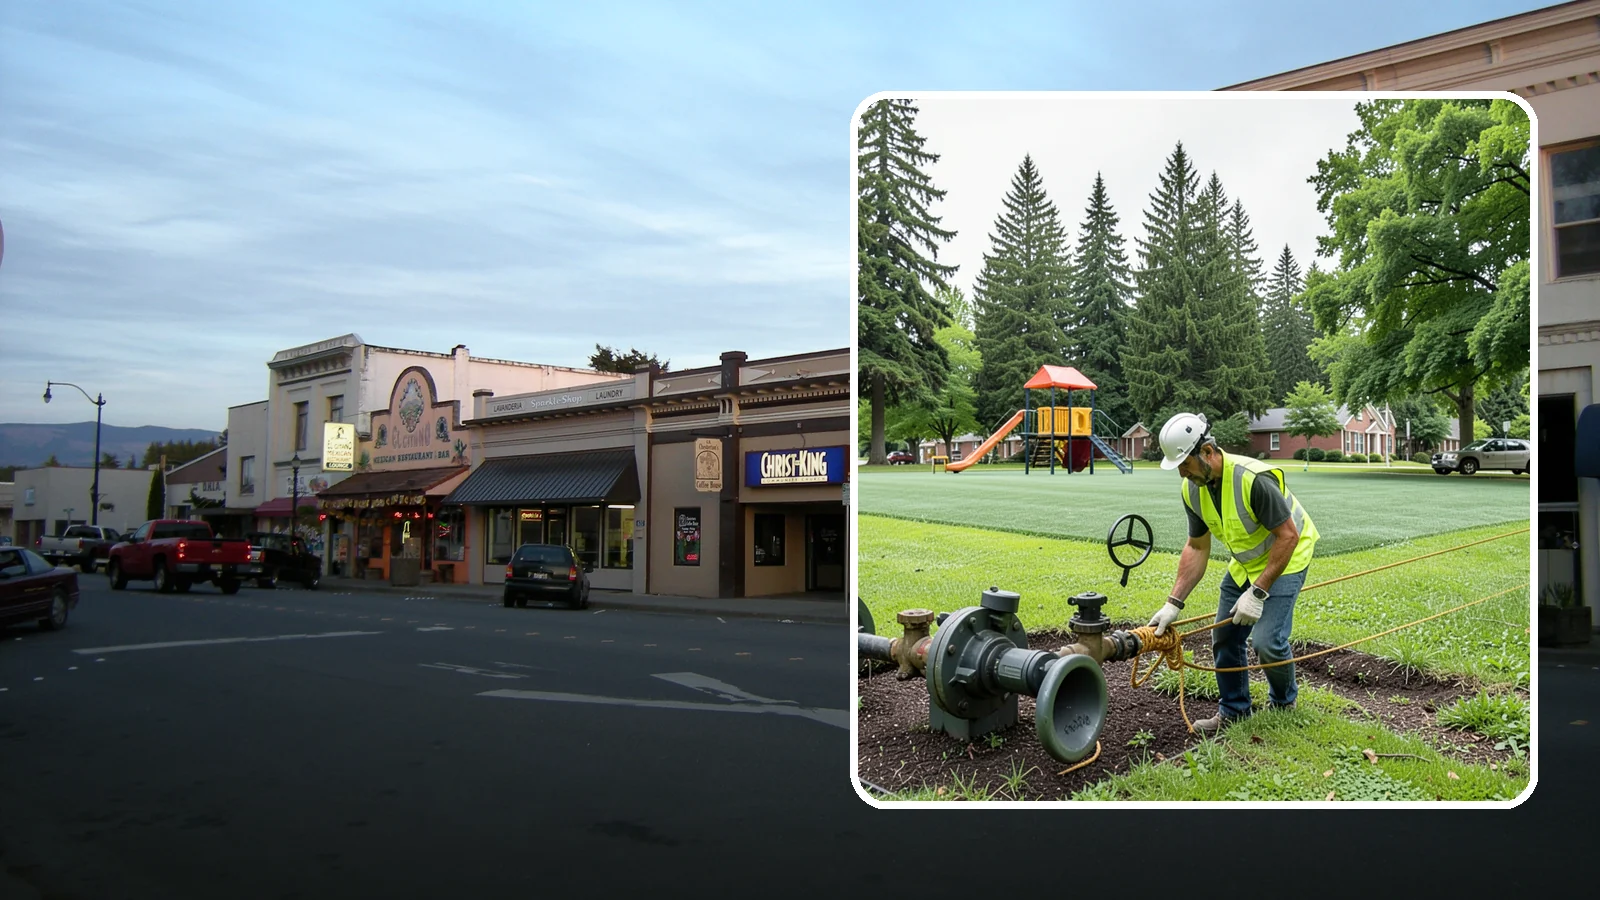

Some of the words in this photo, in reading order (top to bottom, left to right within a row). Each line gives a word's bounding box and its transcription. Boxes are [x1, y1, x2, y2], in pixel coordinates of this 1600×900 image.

[596, 389, 624, 400] LAUNDRY
[494, 402, 522, 412] LAVANDERIA
[530, 398, 560, 408] Sparkle
[562, 395, 582, 405] Shop
[374, 456, 396, 464] MEXICAN
[398, 451, 434, 462] RESTAURANT
[438, 450, 450, 458] BAR
[760, 452, 797, 478] CHRIST
[799, 450, 827, 476] KING
